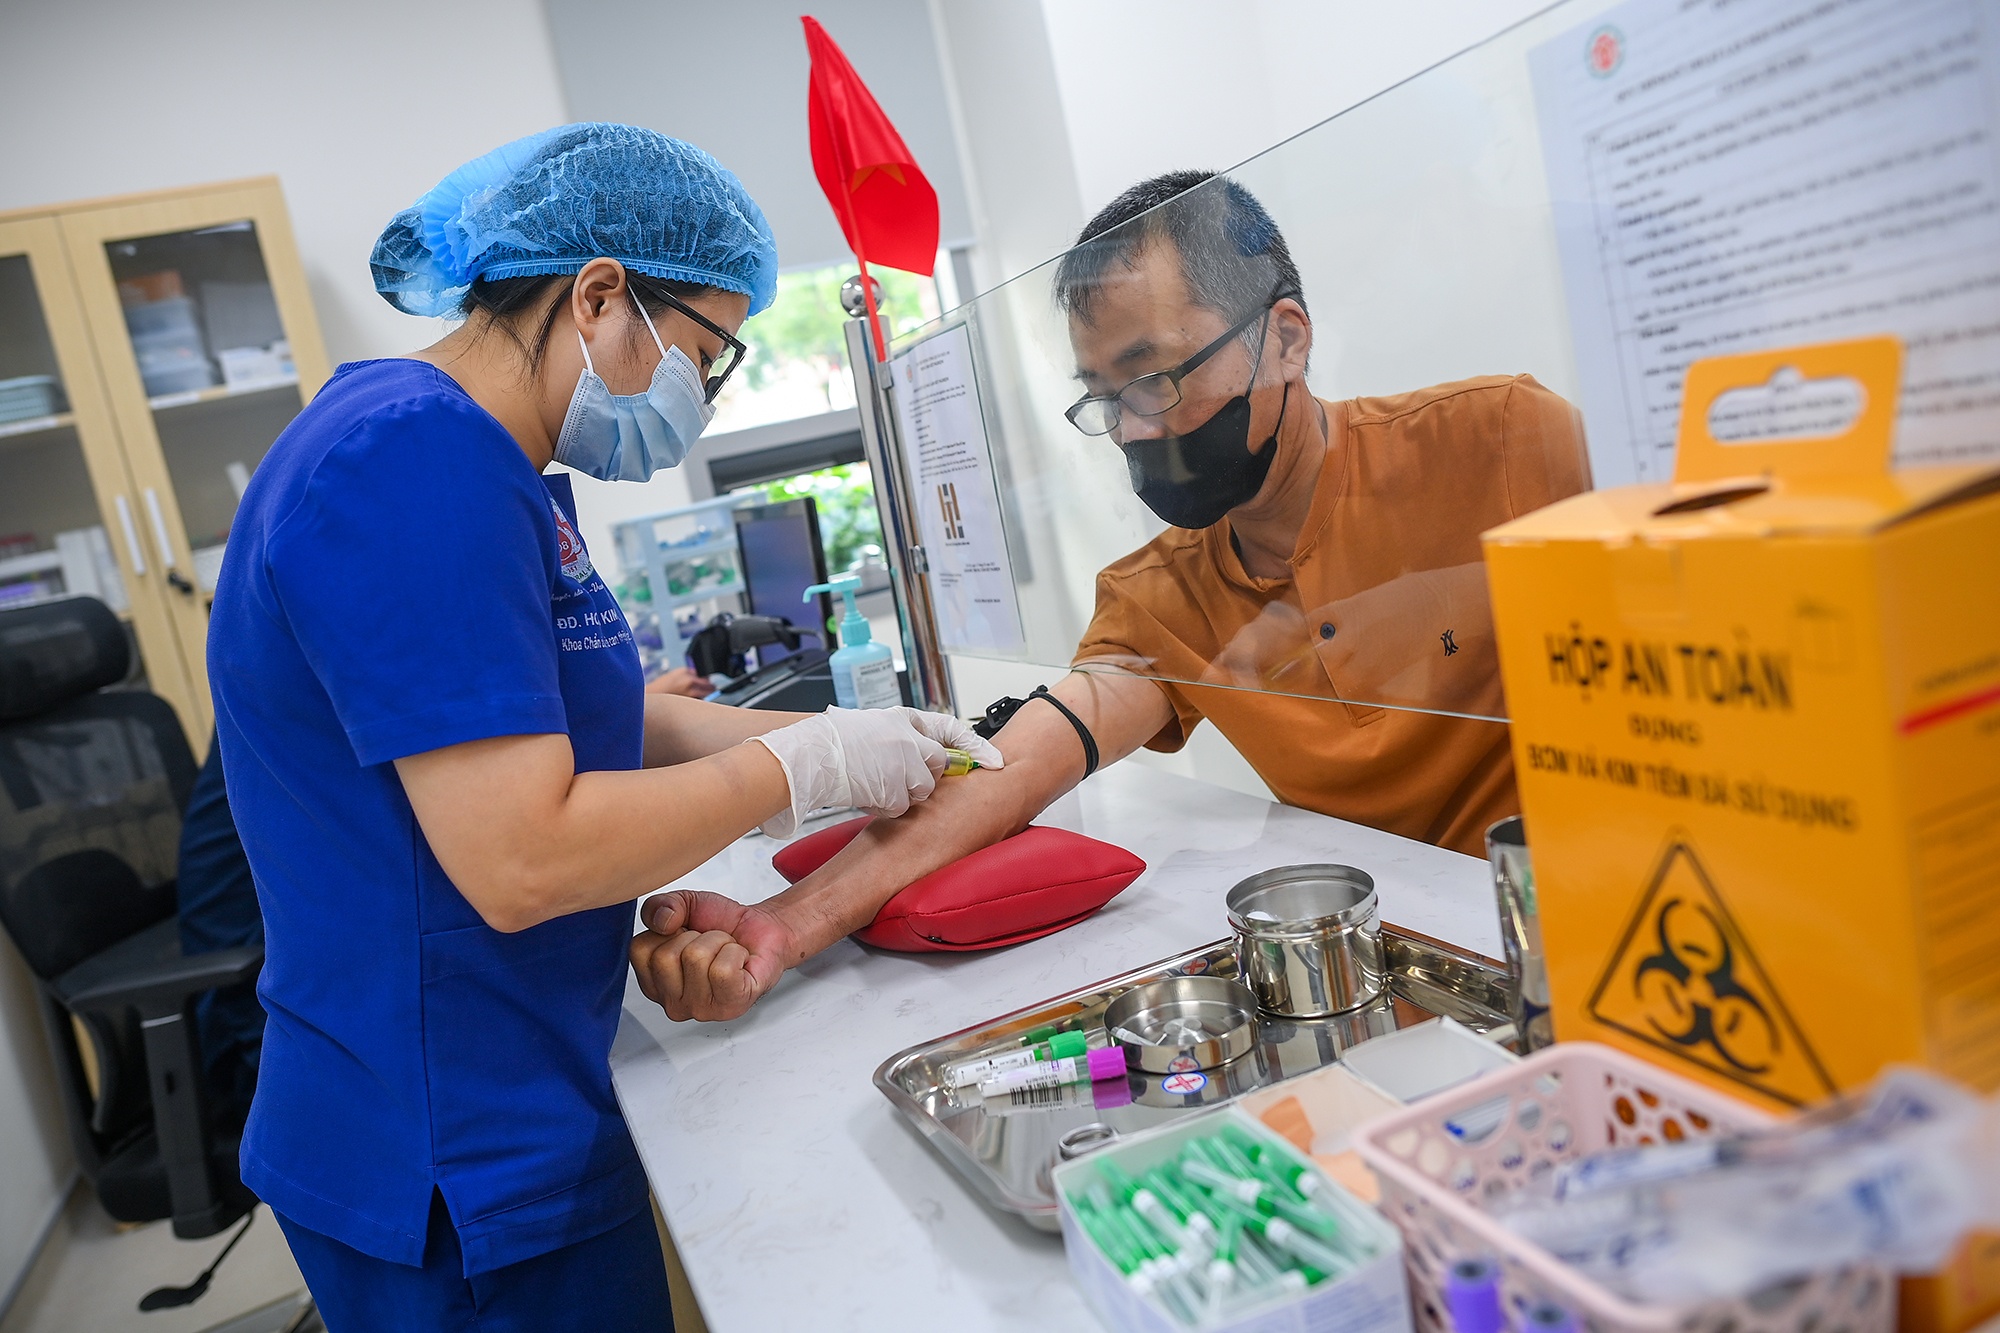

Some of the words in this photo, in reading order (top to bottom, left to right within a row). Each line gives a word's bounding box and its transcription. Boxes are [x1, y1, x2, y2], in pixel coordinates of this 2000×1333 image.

[557, 616, 582, 630] ĐD.
[562, 637, 583, 652] Khoa
[1545, 620, 1612, 703] HỘP
[1621, 640, 1672, 697] AN
[1676, 627, 1795, 710] TOÀN
[1604, 758, 1639, 787] KIM
